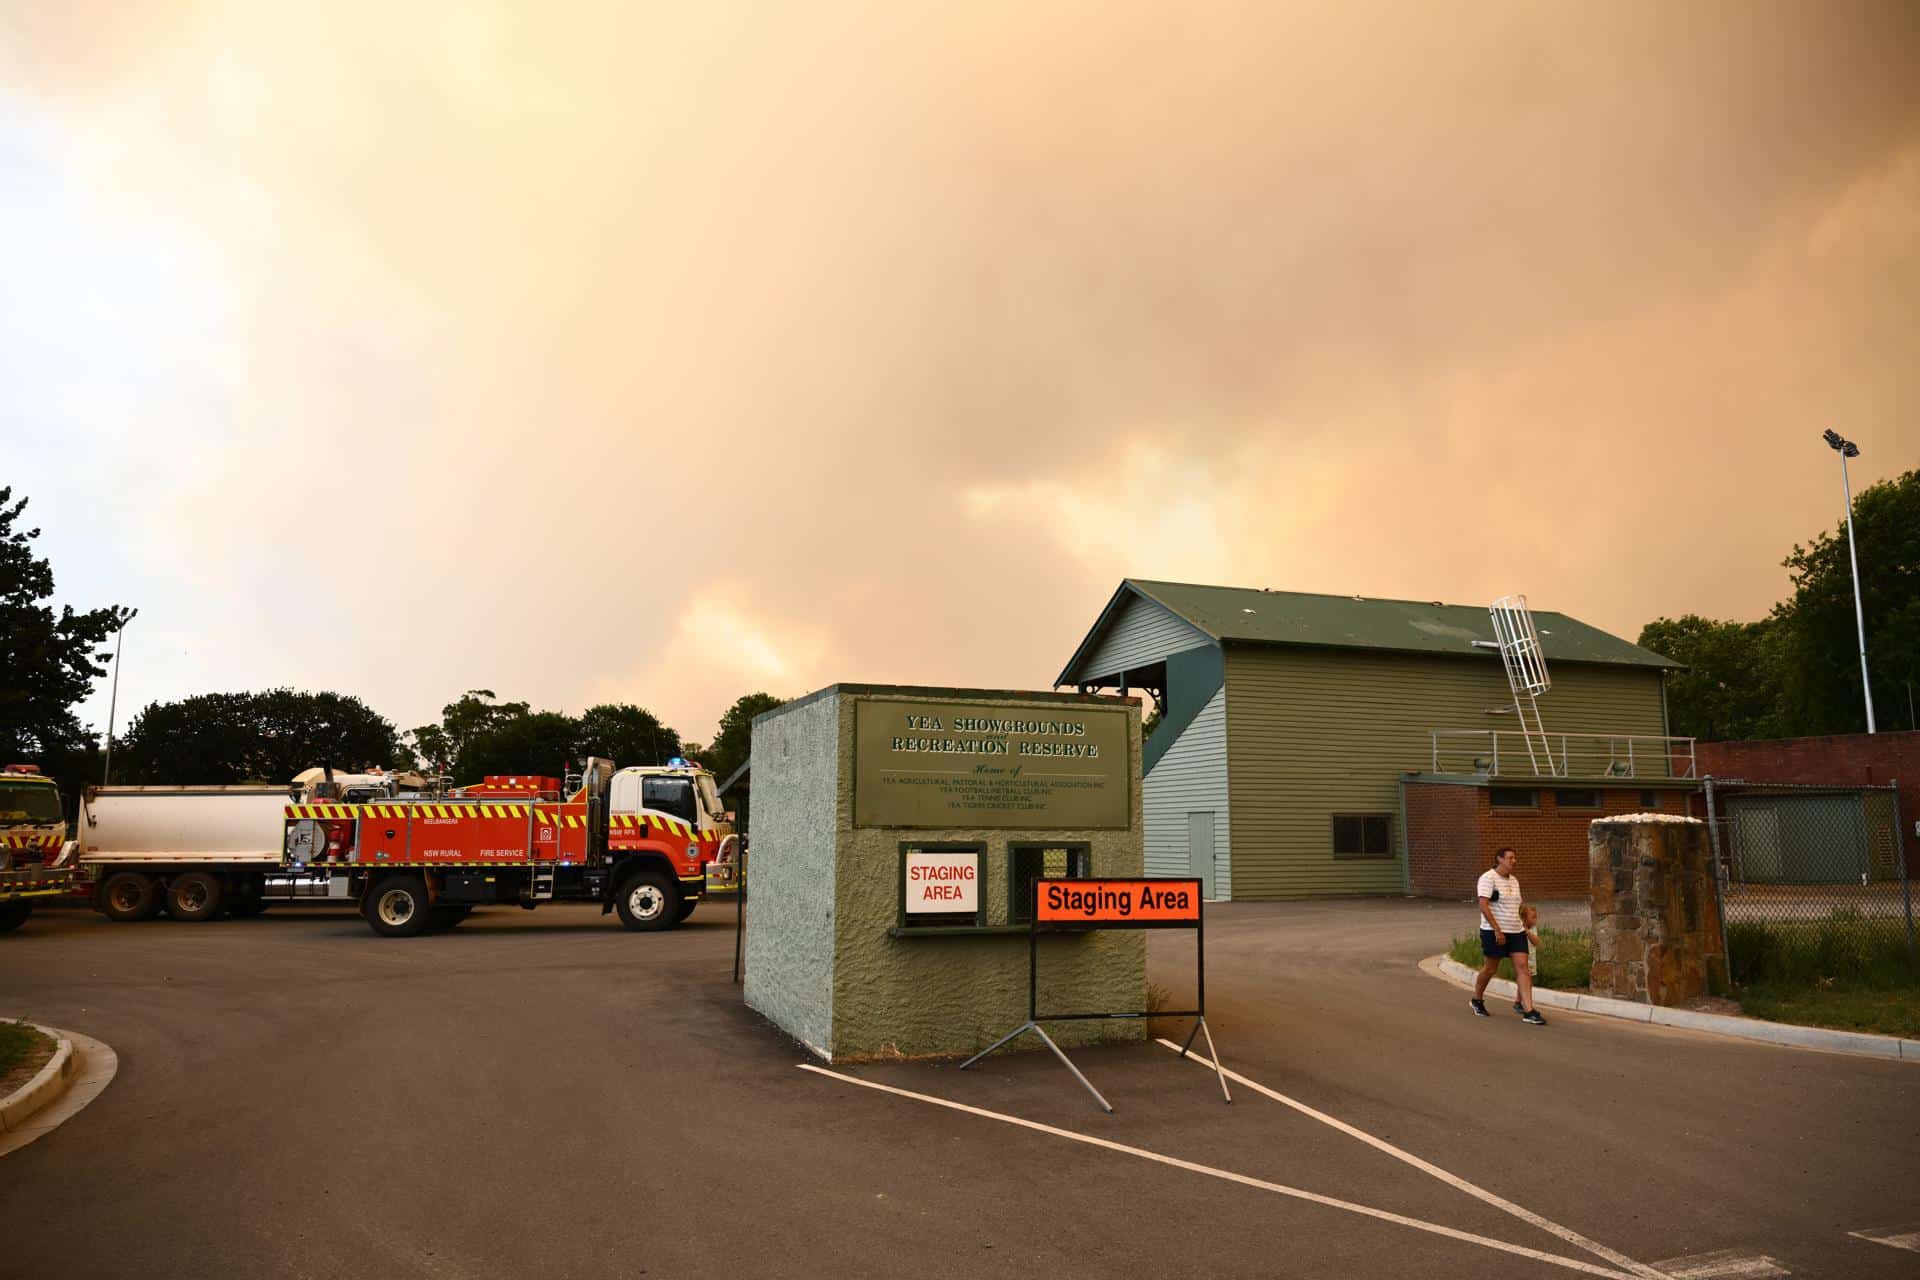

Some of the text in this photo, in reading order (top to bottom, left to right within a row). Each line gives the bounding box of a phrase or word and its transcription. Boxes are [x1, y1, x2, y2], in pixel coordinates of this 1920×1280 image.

[907, 716, 1085, 736] YEA SHOWGROUNDS
[892, 736, 1098, 758] RECREATION RESERVE
[975, 765, 1023, 778] Home of
[423, 849, 462, 857] NSW RURAL
[480, 849, 524, 857] FIRE SERVICE
[911, 866, 975, 881] STAGING
[923, 885, 963, 900] AREA
[1047, 885, 1189, 916] Staging Area
